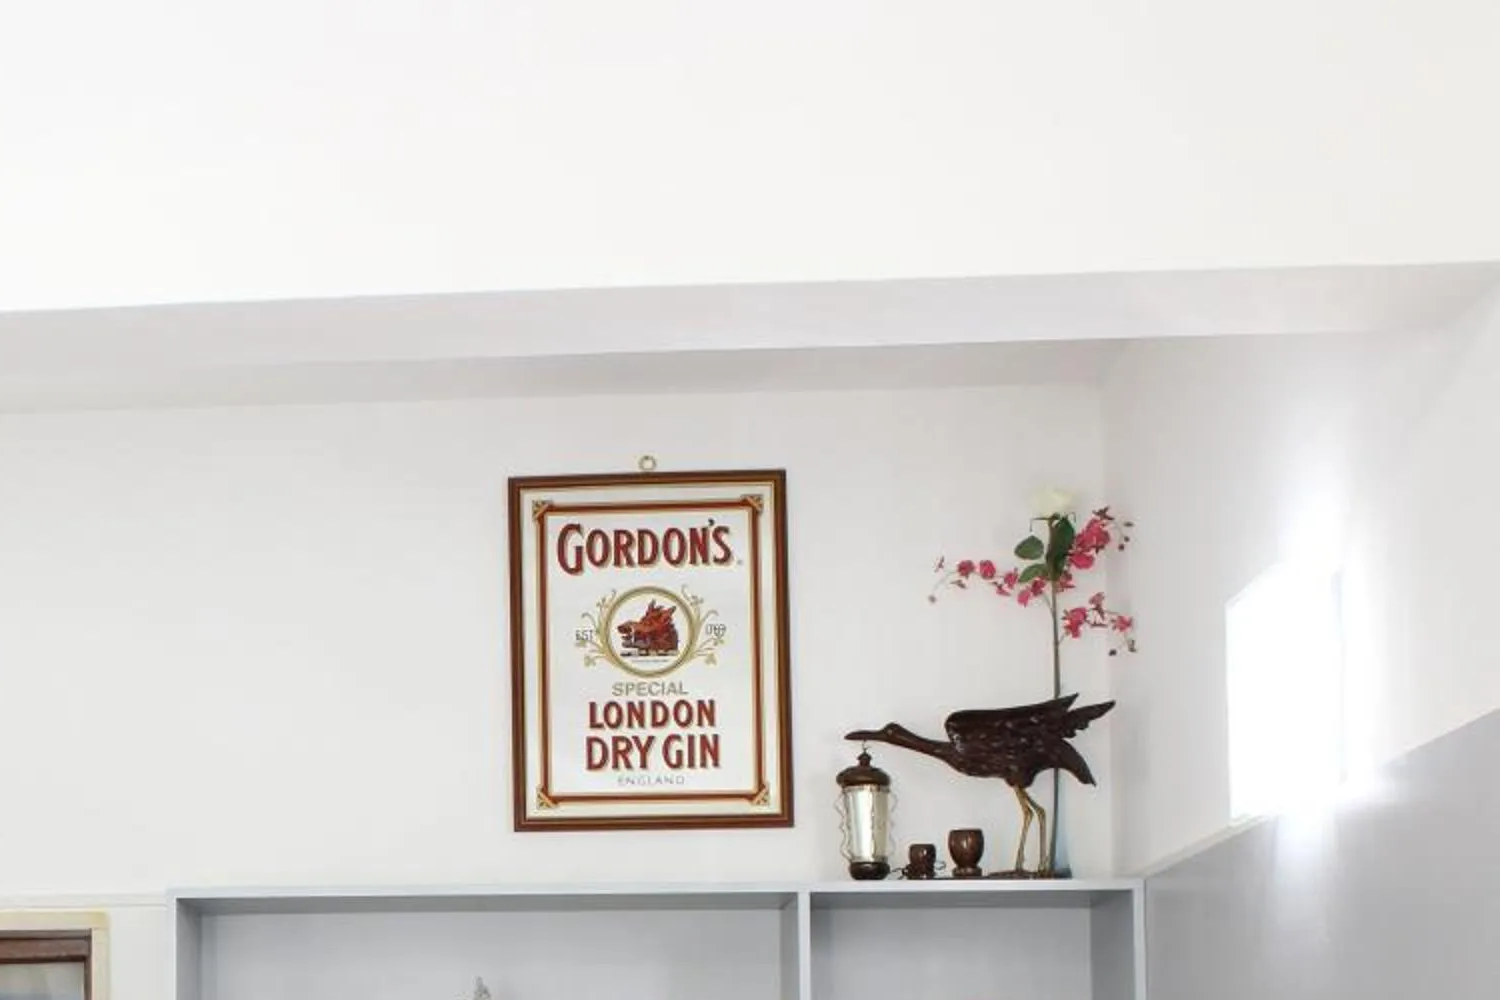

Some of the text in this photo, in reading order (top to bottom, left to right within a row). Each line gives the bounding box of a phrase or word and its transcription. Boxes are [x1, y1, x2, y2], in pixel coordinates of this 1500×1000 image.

[557, 518, 733, 576] GORDON'S
[611, 681, 688, 697] SPECIAL
[589, 699, 716, 730] LONDON
[585, 733, 722, 772] DRY GIN
[617, 774, 686, 786] ENGLAND
